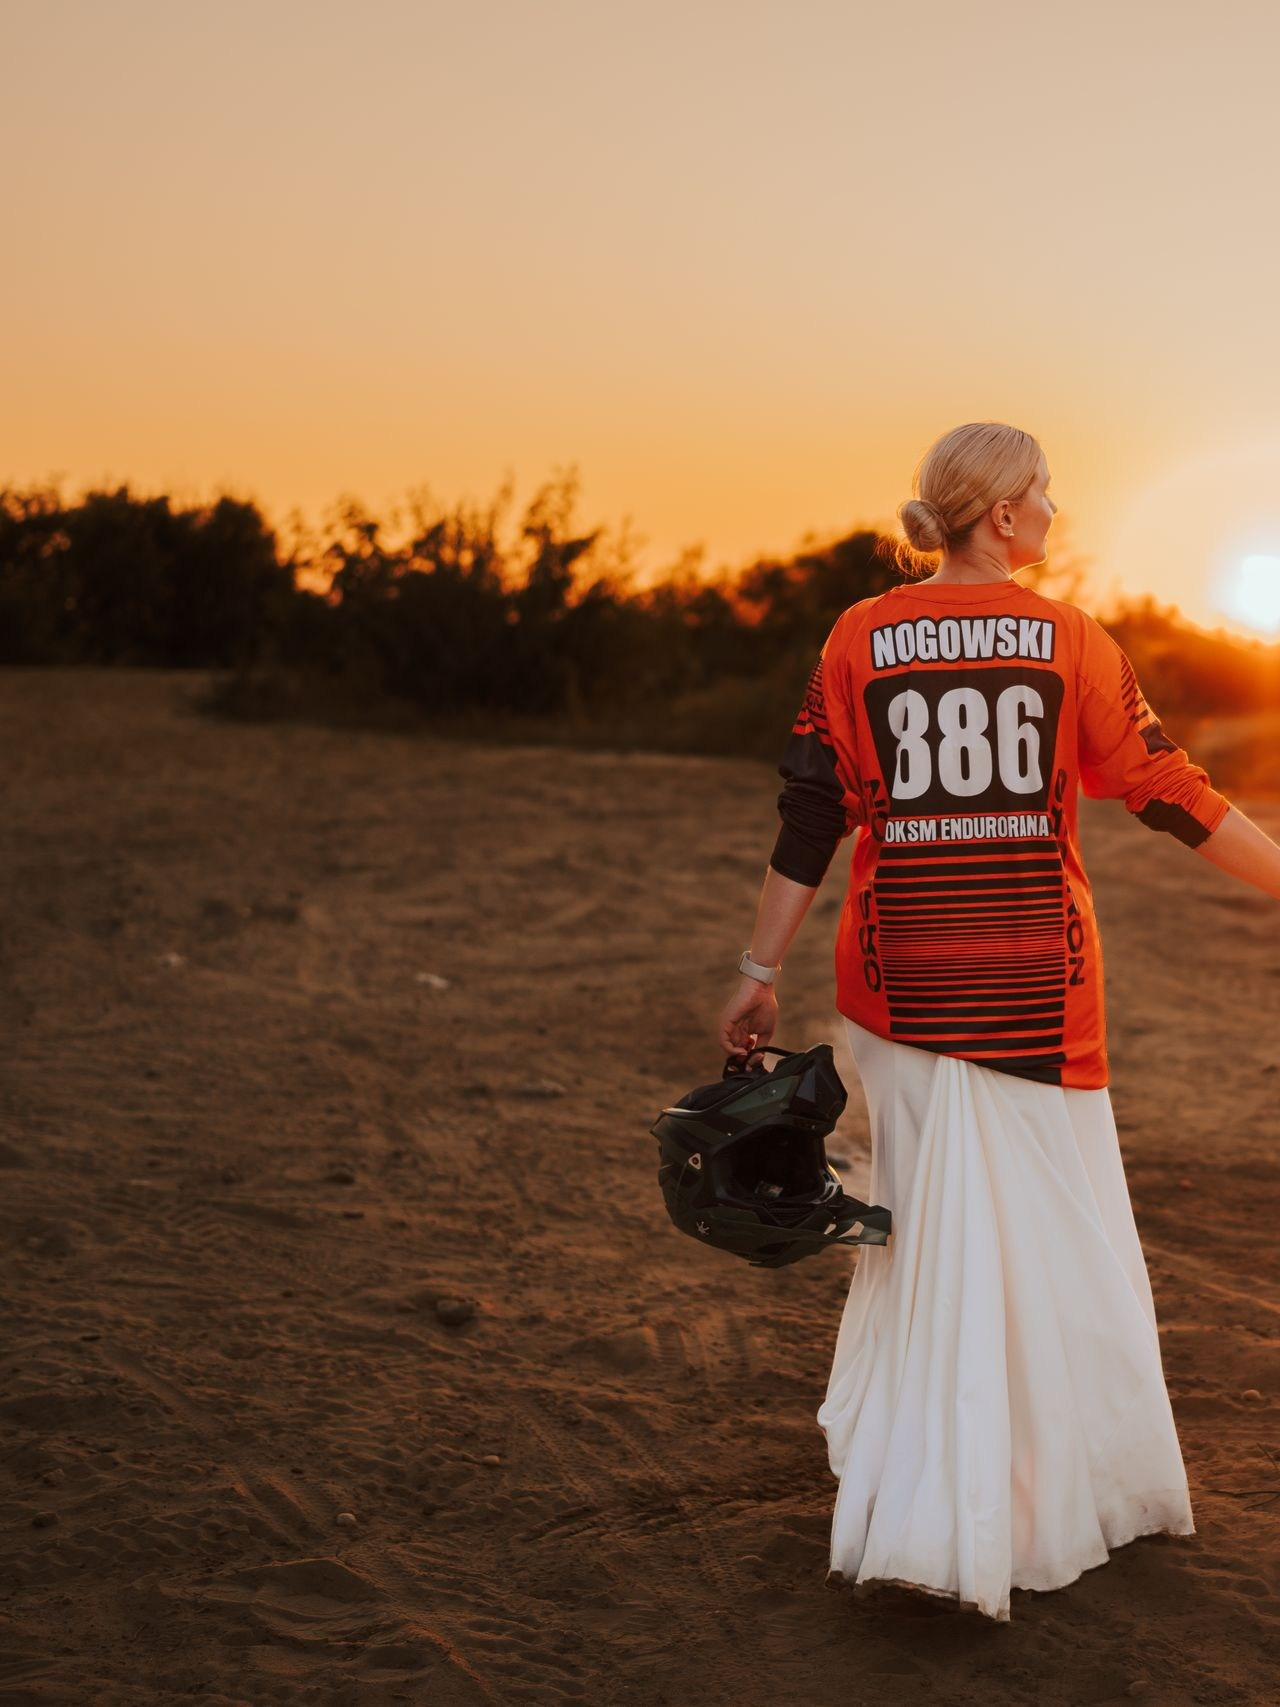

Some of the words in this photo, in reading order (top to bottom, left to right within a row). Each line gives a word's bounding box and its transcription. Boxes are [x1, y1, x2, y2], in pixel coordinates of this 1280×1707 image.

[872, 616, 1054, 669] NOGOWSKI
[887, 684, 1045, 800] 886
[884, 818, 937, 843] OKSM
[940, 814, 1050, 841] ENDURORANA
